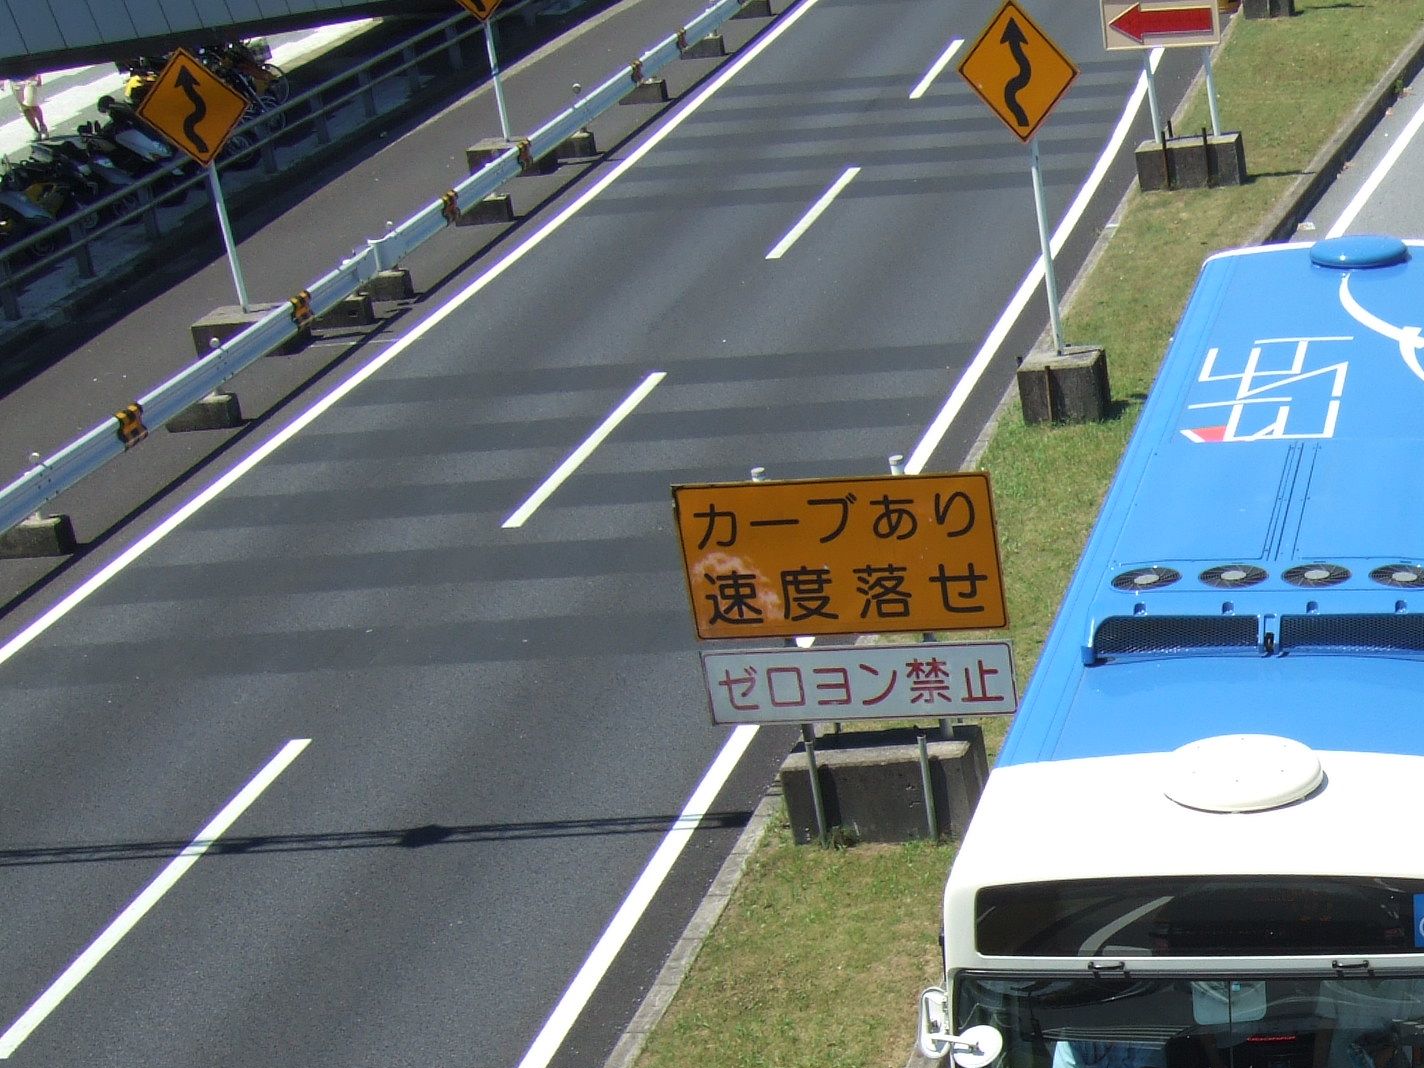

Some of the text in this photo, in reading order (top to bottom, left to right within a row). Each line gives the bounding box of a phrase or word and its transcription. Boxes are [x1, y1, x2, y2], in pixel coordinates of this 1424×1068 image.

[693, 491, 975, 550] カーブあり
[705, 563, 988, 625] 速度落せ
[719, 657, 1004, 710] ゼロヨン禁止
